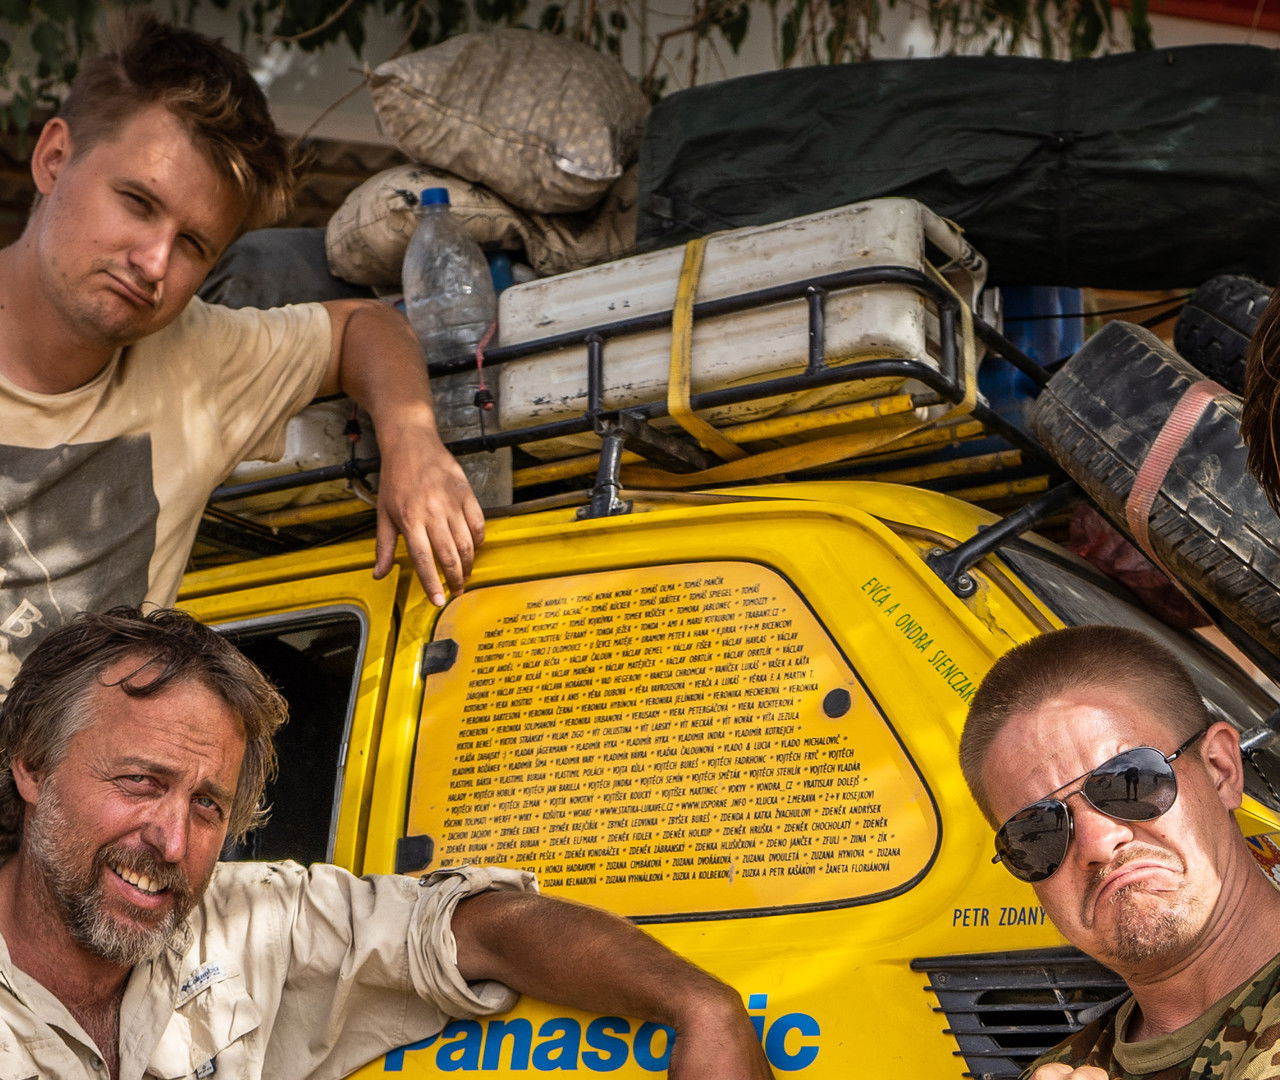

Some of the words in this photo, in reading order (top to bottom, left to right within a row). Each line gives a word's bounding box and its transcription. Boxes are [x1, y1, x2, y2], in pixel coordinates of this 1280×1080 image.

[895, 613, 934, 653] ONDRA
[928, 649, 978, 706] SIENCZAK
[768, 866, 784, 876] PETR
[952, 908, 990, 927] PETR
[384, 994, 820, 1072] anasoic
